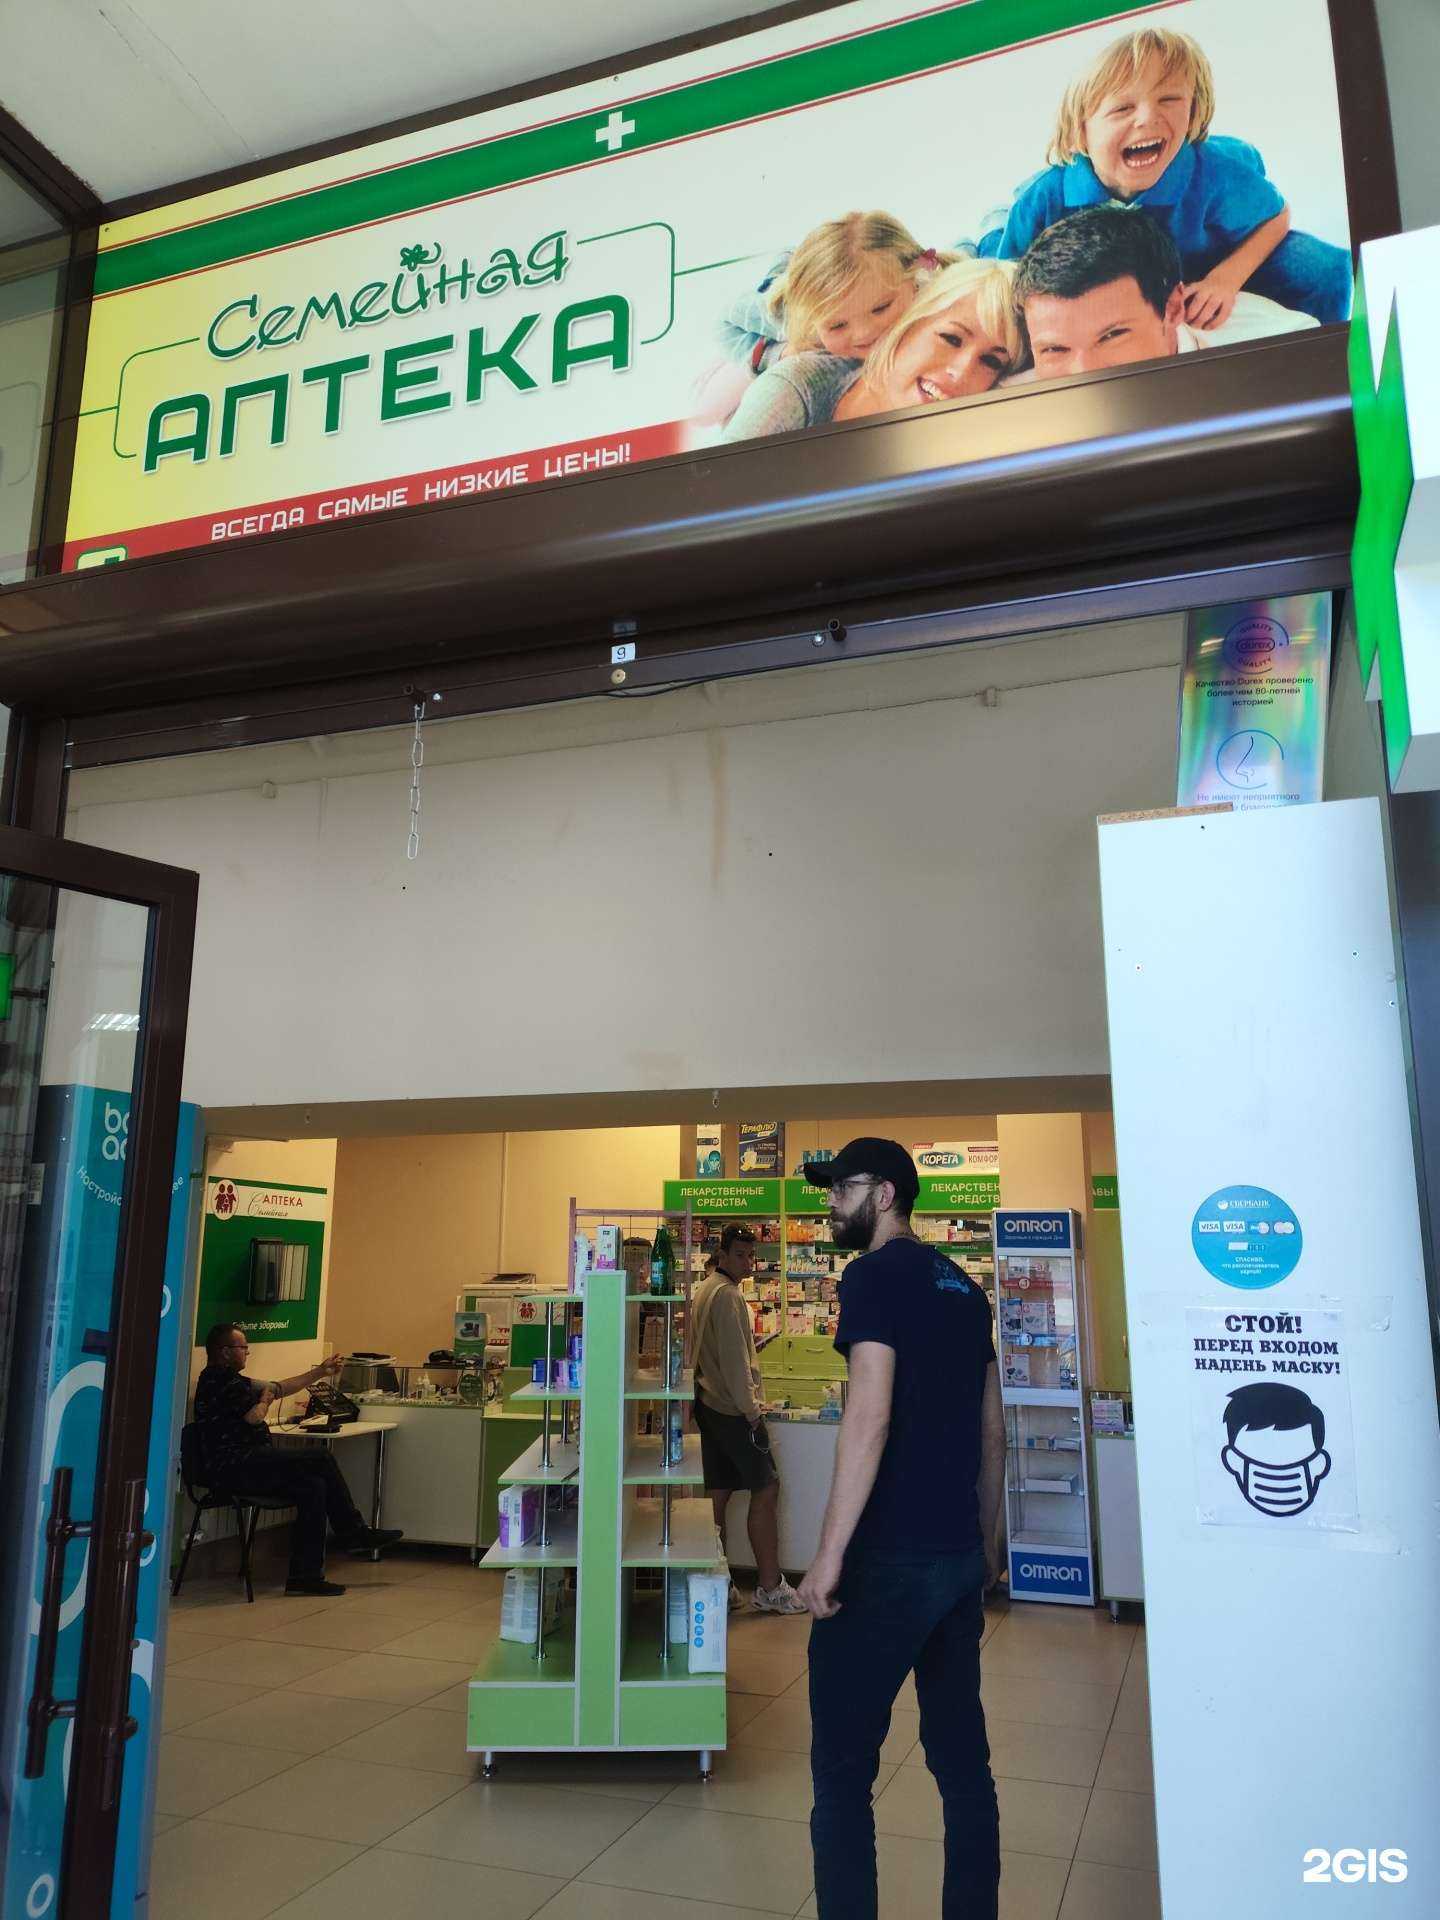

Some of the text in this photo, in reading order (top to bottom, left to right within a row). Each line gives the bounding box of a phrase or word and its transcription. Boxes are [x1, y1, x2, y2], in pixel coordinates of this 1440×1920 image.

[207, 230, 569, 360] Семейная
[142, 294, 631, 473] АПТЕКА
[211, 442, 631, 541] ВСЕГДА САМЫЕ НИЗКИЕ ЦЕНЫ!
[1265, 676, 1314, 686] проверено
[1232, 698, 1273, 707] историей
[922, 1155, 959, 1165] КОРЕГА
[680, 1187, 764, 1196] ЛЕКАРСТВЕННЫЕ
[801, 1186, 831, 1195] ЛЕКА
[262, 1194, 304, 1208] АПТЕКА
[697, 1198, 747, 1207] СРЕДСТВА
[1224, 1312, 1302, 1334] СТОЙ!
[1193, 1338, 1339, 1356] ПЕРЕД ВХОДОМ
[1194, 1358, 1341, 1375] НАДЕНЬ МАСКУ!
